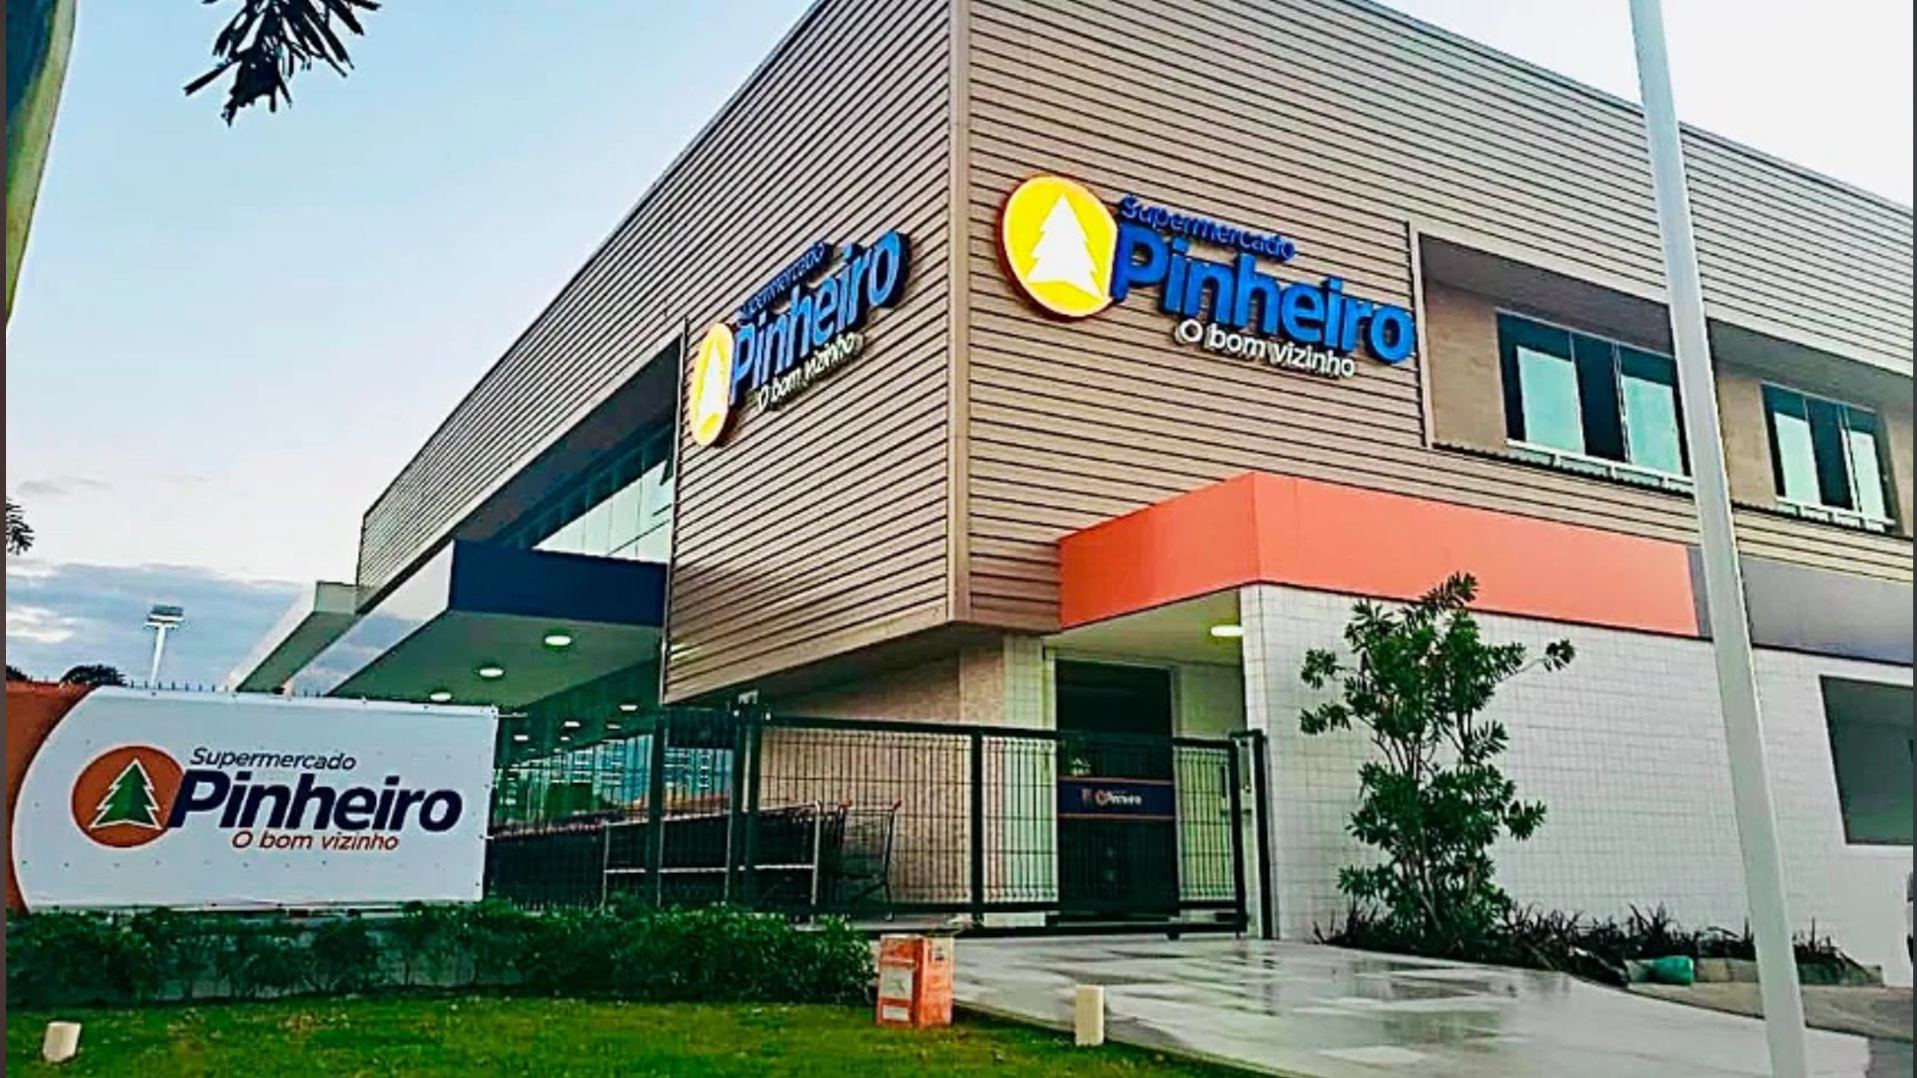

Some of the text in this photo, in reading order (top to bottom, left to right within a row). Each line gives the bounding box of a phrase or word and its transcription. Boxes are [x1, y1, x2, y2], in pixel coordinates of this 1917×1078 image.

[1119, 194, 1296, 263] Supermercado
[729, 228, 905, 406] Pinheiro
[1111, 221, 1417, 365] Pinheiro
[770, 366, 803, 402] bom
[803, 331, 858, 377] vizinho
[1176, 319, 1356, 379] O bom vizinho
[189, 746, 357, 772] Supermercado
[167, 768, 464, 833] Pinheiro
[232, 831, 399, 851] O bom vizinho
